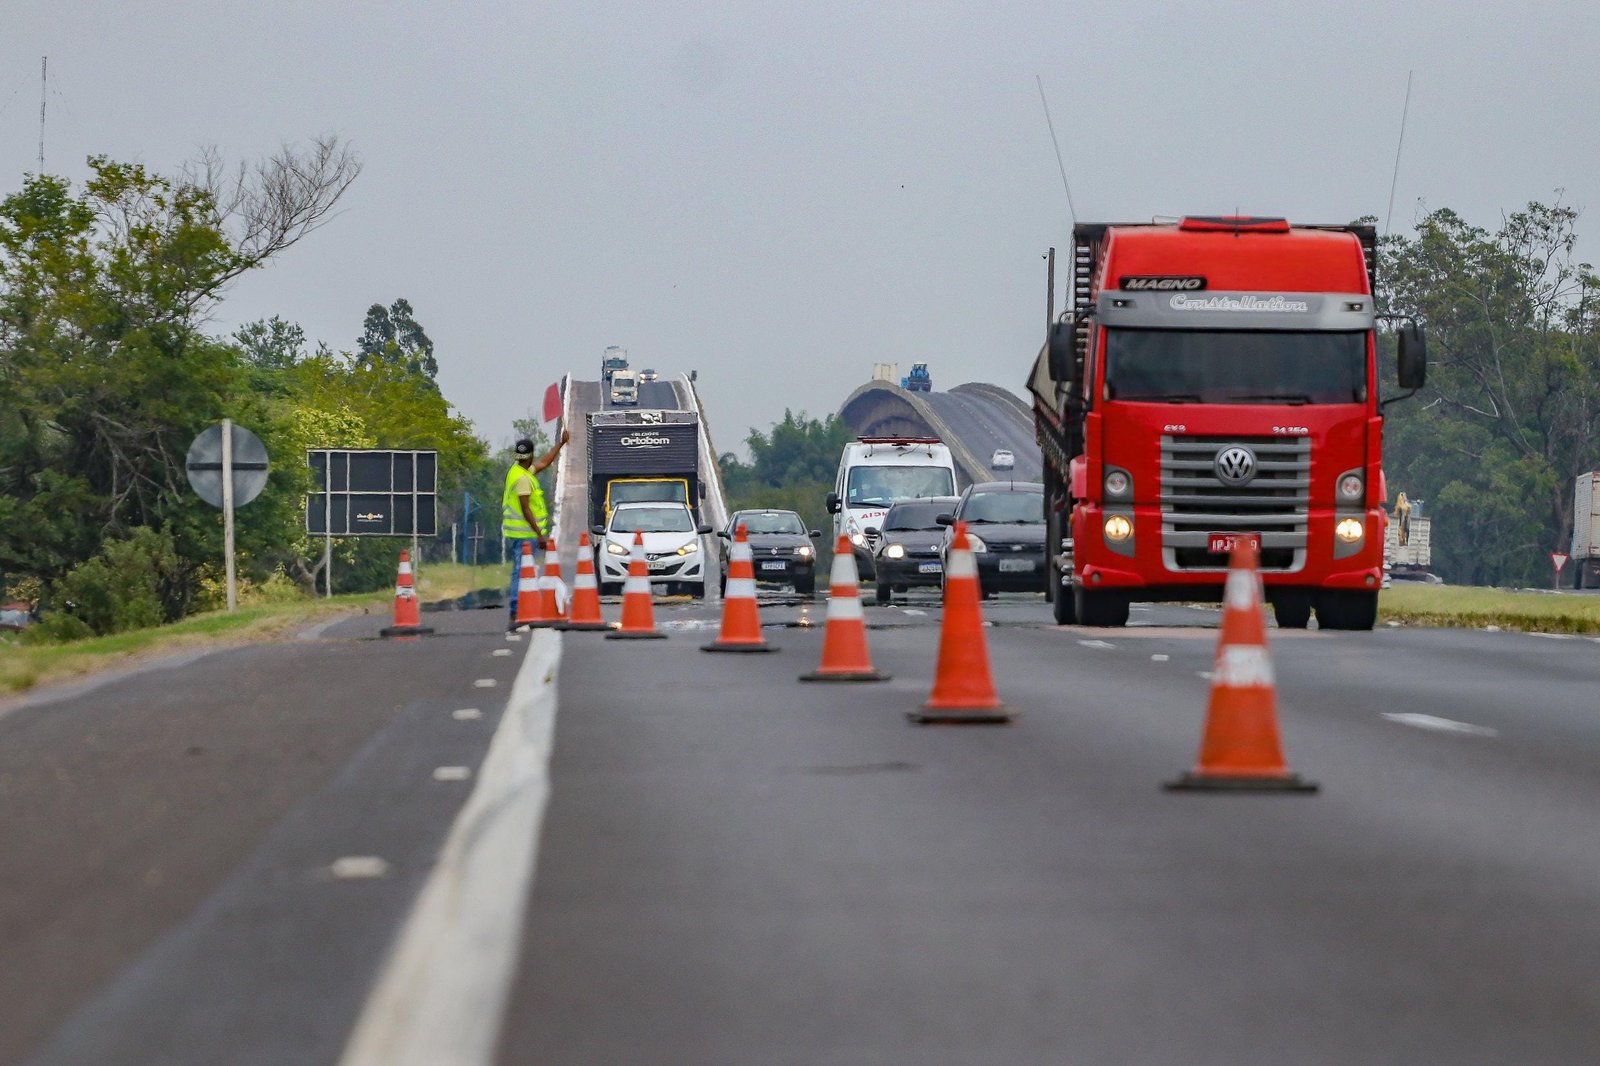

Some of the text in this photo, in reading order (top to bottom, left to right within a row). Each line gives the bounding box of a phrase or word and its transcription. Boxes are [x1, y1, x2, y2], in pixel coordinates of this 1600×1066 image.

[1126, 279, 1200, 289] MAGNO
[1169, 294, 1308, 312] Constellation
[620, 437, 670, 446] Ortobom
